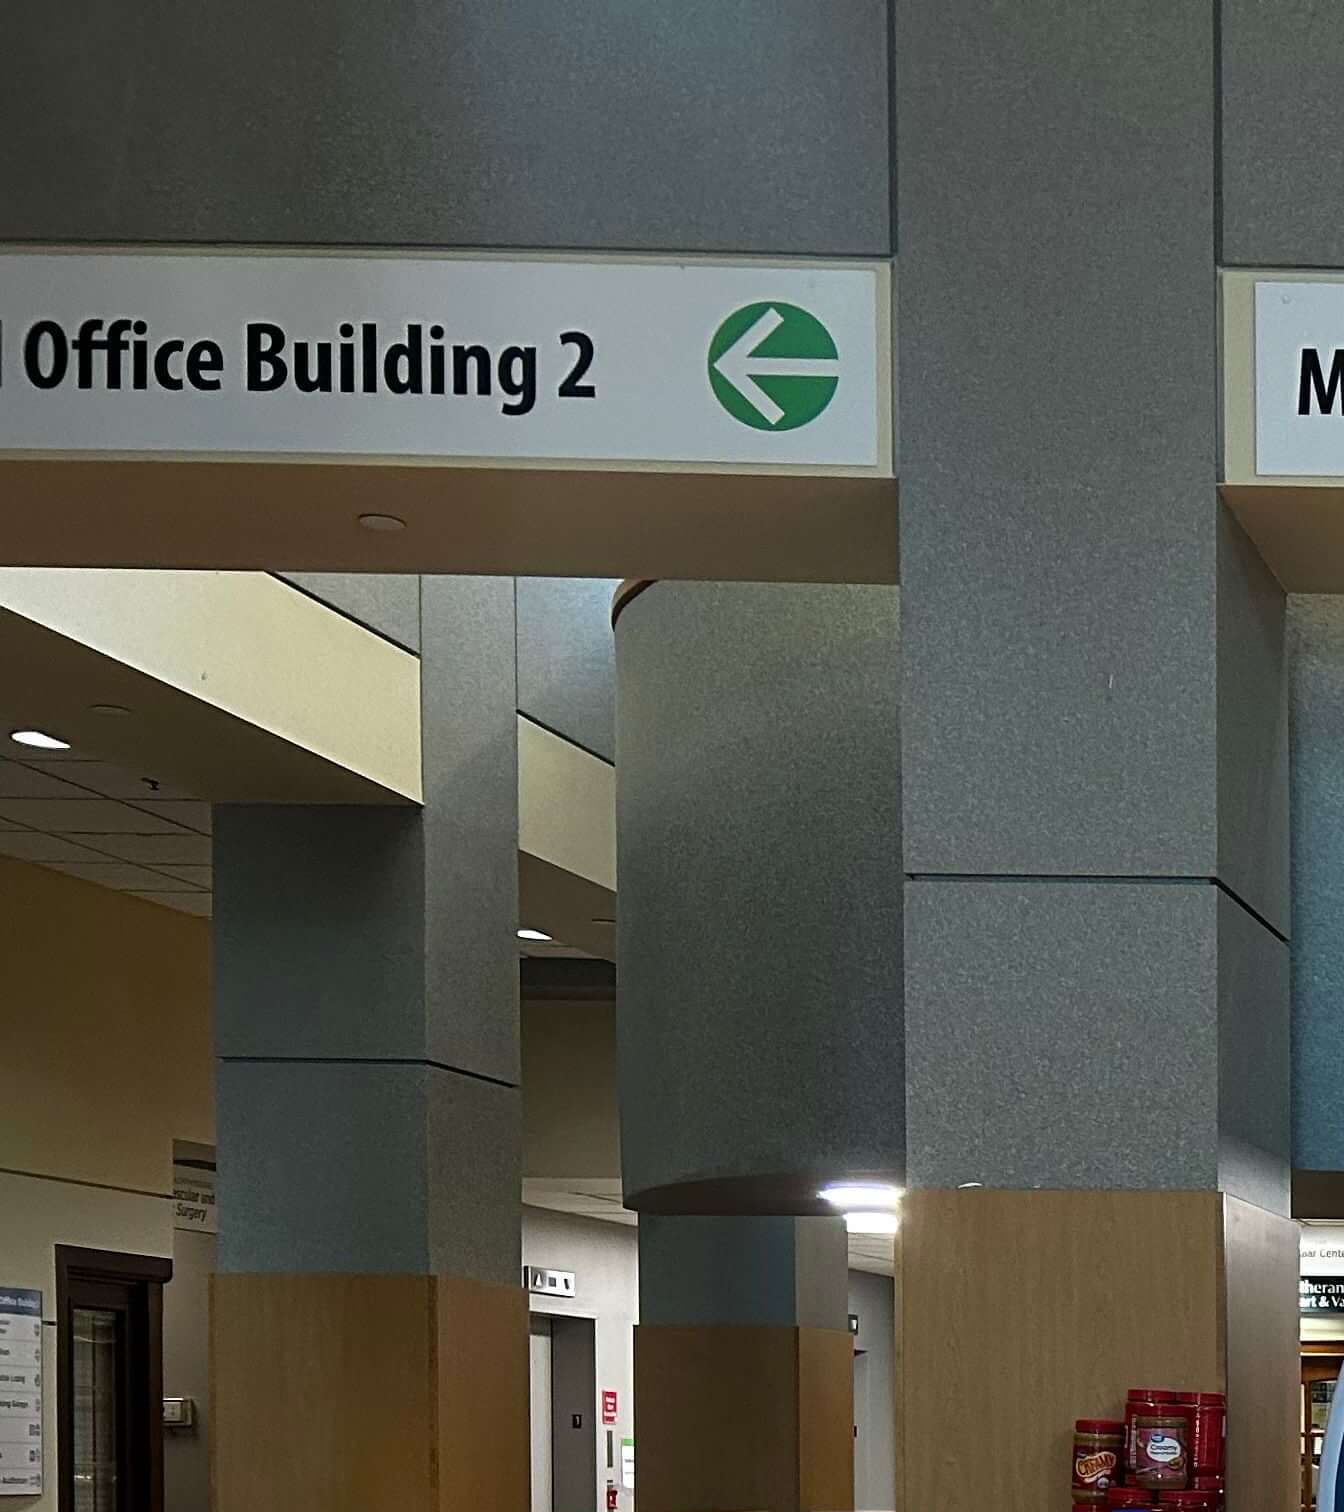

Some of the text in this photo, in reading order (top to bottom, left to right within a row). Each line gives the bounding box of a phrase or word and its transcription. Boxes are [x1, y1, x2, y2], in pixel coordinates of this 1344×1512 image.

[24, 320, 596, 415] Office Building 2
